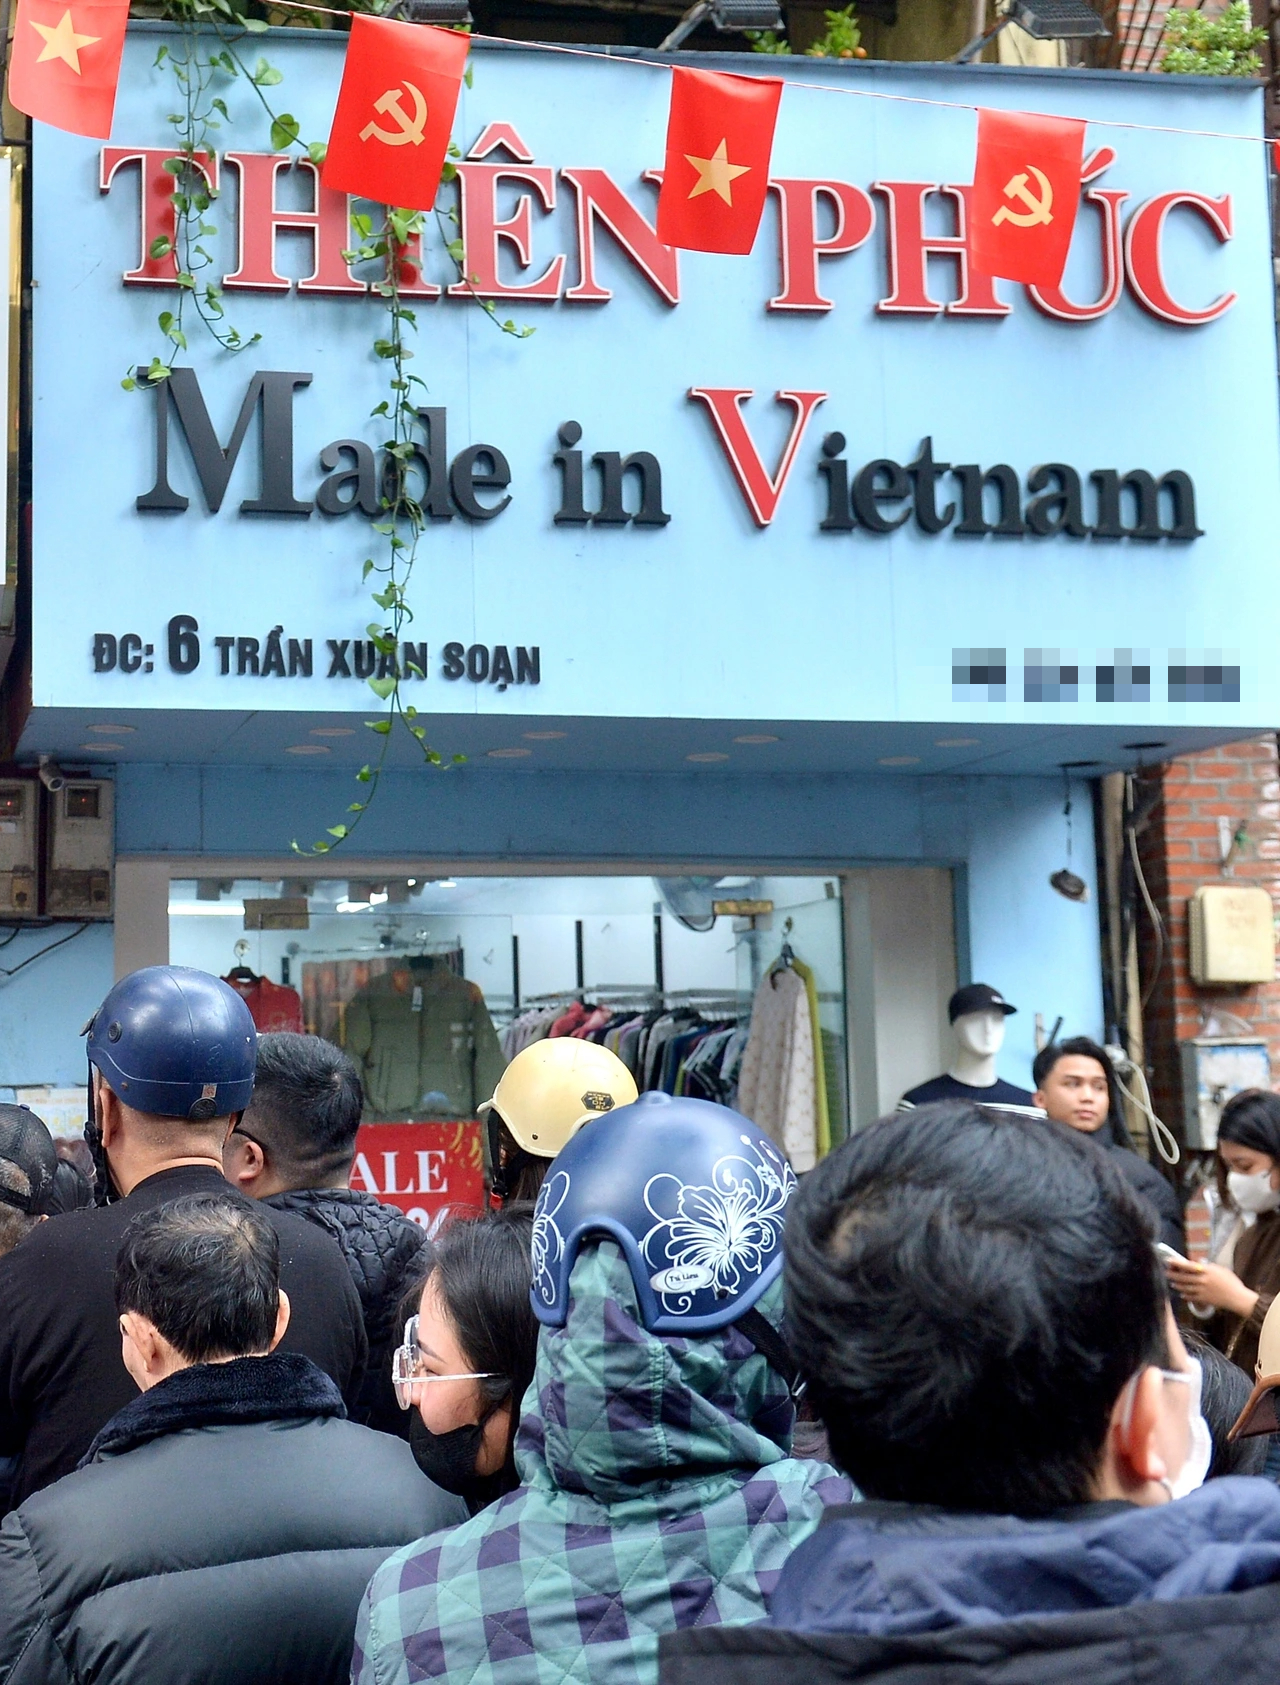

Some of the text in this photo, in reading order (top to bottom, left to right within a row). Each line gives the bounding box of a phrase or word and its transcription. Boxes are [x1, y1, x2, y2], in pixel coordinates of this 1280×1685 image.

[134, 366, 1206, 540] Made in Vietnam
[93, 632, 154, 674] ĐC:
[167, 614, 200, 675] 6
[442, 641, 541, 692] SOẠN
[349, 1150, 449, 1195] ALE
